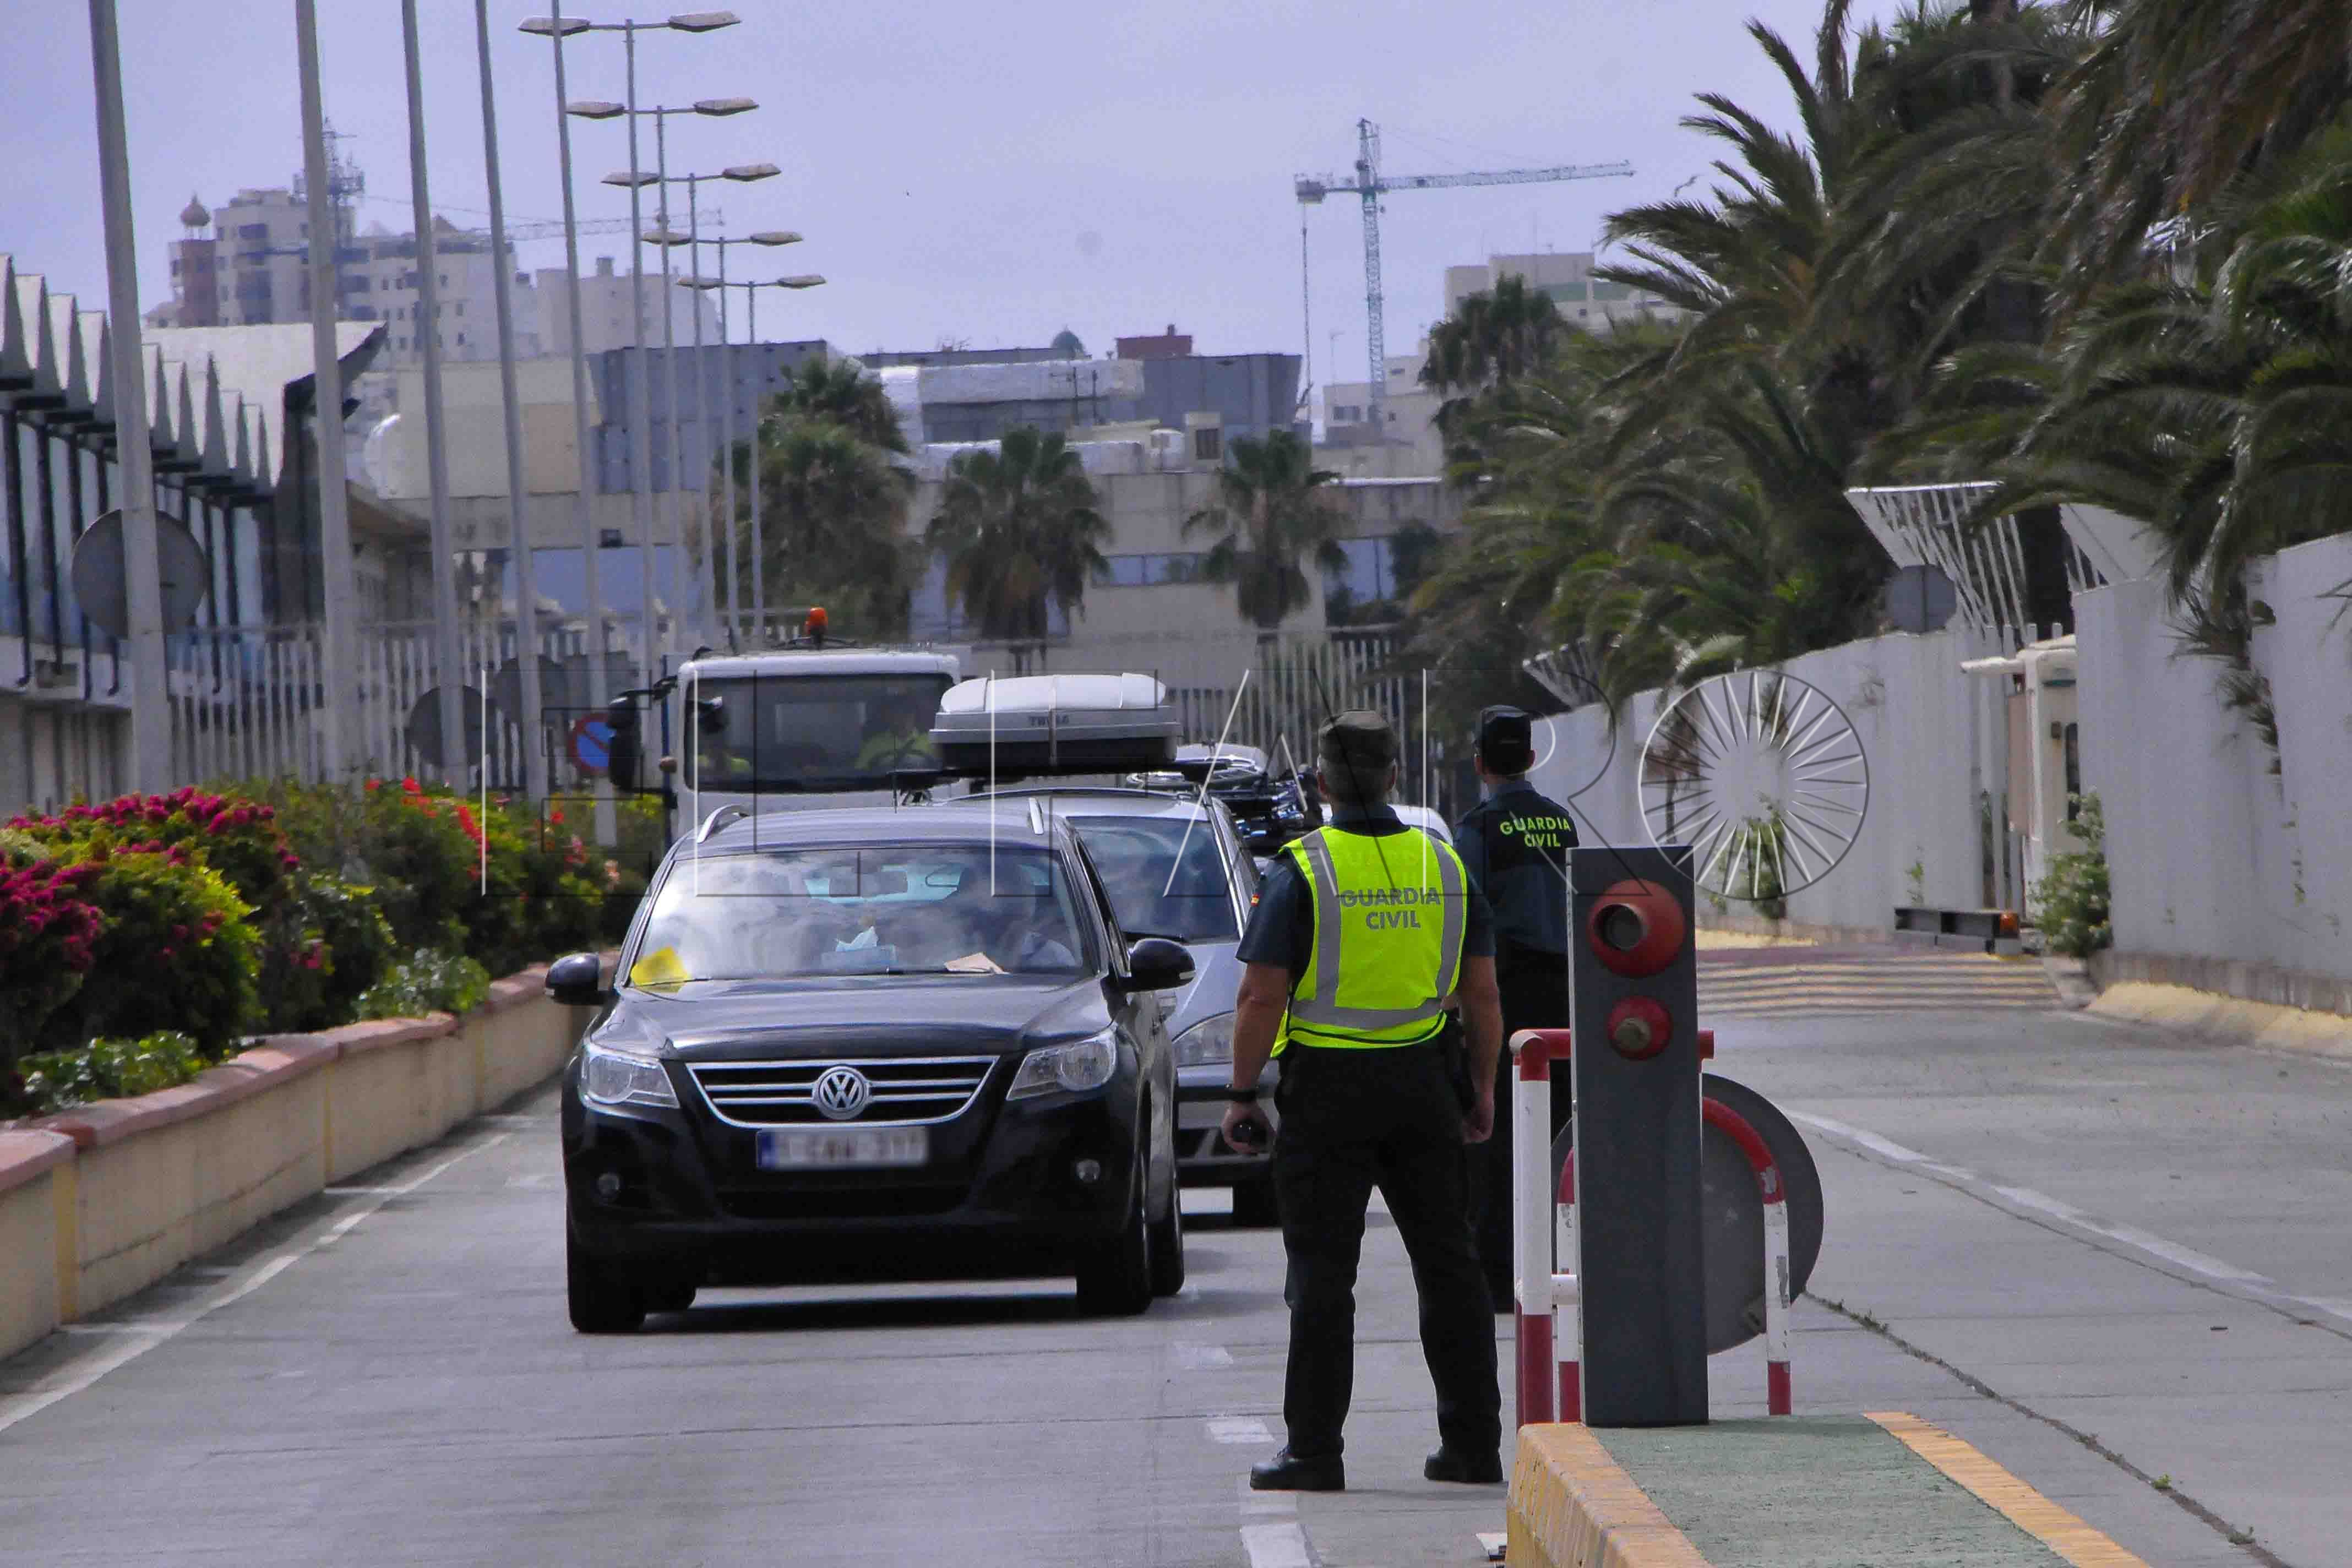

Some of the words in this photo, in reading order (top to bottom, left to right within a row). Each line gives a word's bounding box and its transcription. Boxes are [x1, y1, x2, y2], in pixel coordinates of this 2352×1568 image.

[1499, 817, 1571, 835] GUARDIA
[1524, 833, 1561, 847] CIVIL
[1340, 887, 1441, 907] GUARDIA
[1365, 910, 1421, 930] CIVIL
